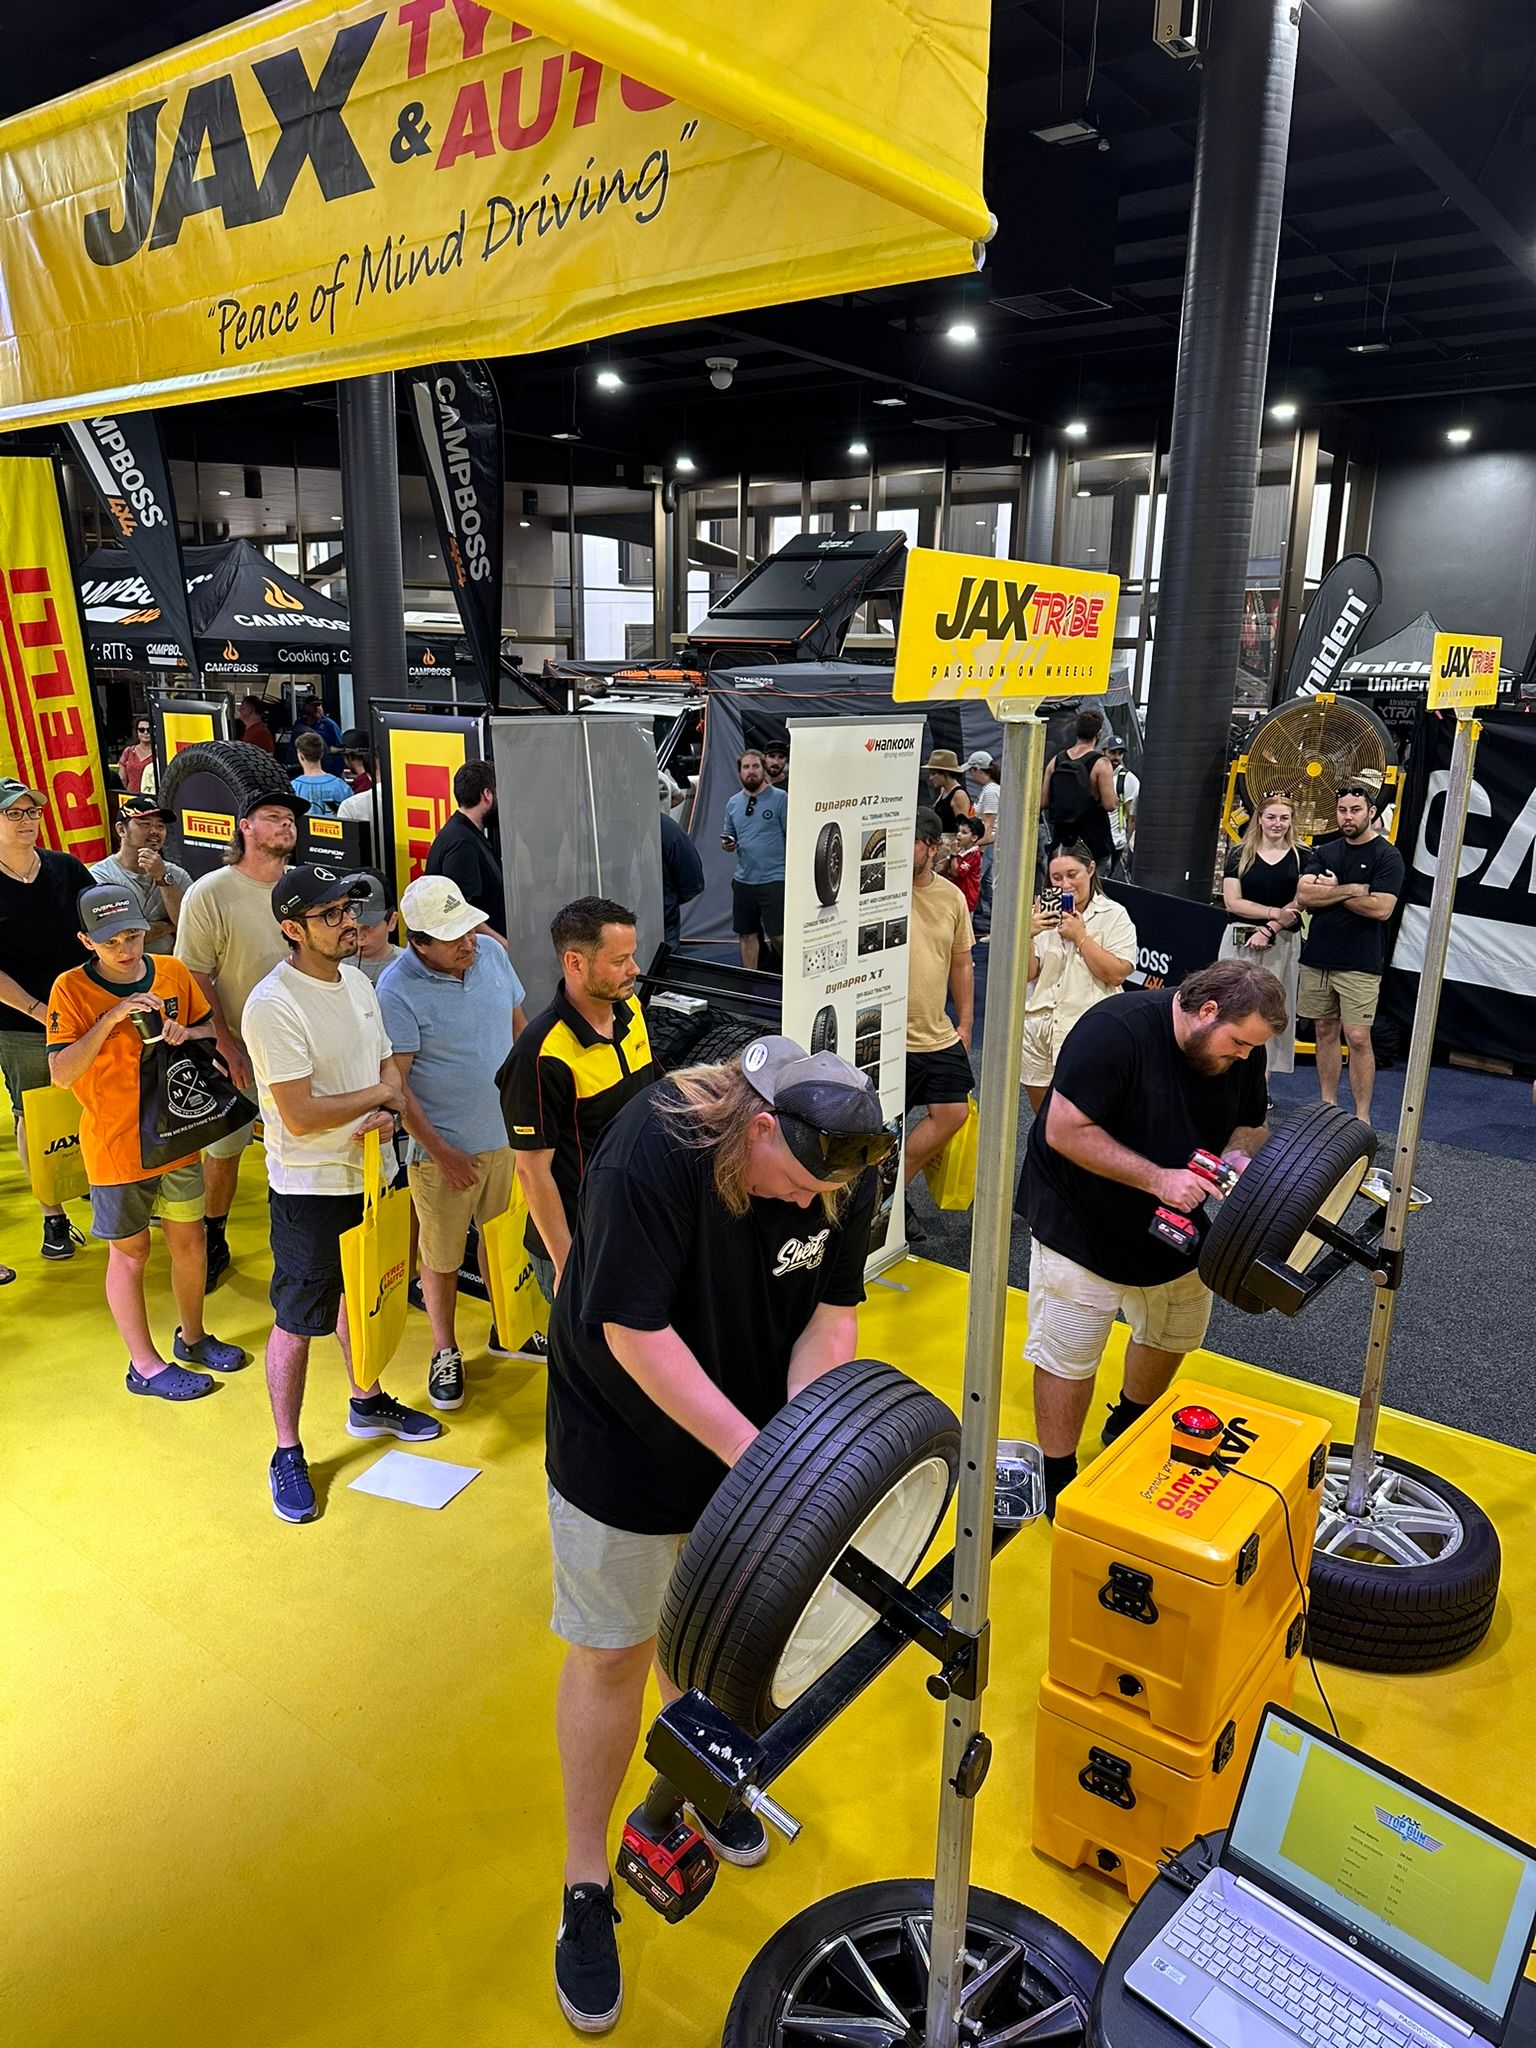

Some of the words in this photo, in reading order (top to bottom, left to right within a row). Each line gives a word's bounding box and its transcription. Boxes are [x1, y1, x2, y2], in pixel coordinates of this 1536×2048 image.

[1166, 25, 1173, 36] 3
[84, 12, 388, 266] JAX
[390, 101, 432, 164] &
[310, 254, 348, 335] of
[356, 209, 465, 305] Mind
[435, 377, 491, 583] CAMPBOSS
[935, 577, 1038, 641] JAX
[1032, 591, 1104, 638] TRIBE
[103, 643, 134, 661] RTT's
[277, 648, 330, 666] Cooking
[204, 662, 259, 673] CAMPBOSS
[408, 666, 451, 676] CAMPBOSS
[931, 664, 1006, 679] PASSION
[1018, 665, 1034, 677] ON
[1046, 665, 1094, 677] WHEELS
[1440, 646, 1474, 679] JAX
[187, 815, 231, 836] PIRELLI
[182, 1071, 193, 1081] M
[172, 1088, 184, 1099] M
[1157, 1473, 1196, 1511] AUTO
[1175, 1476, 1220, 1520] TYRES
[1387, 1815, 1406, 1831] TOP
[1398, 1814, 1421, 1829] JAX
